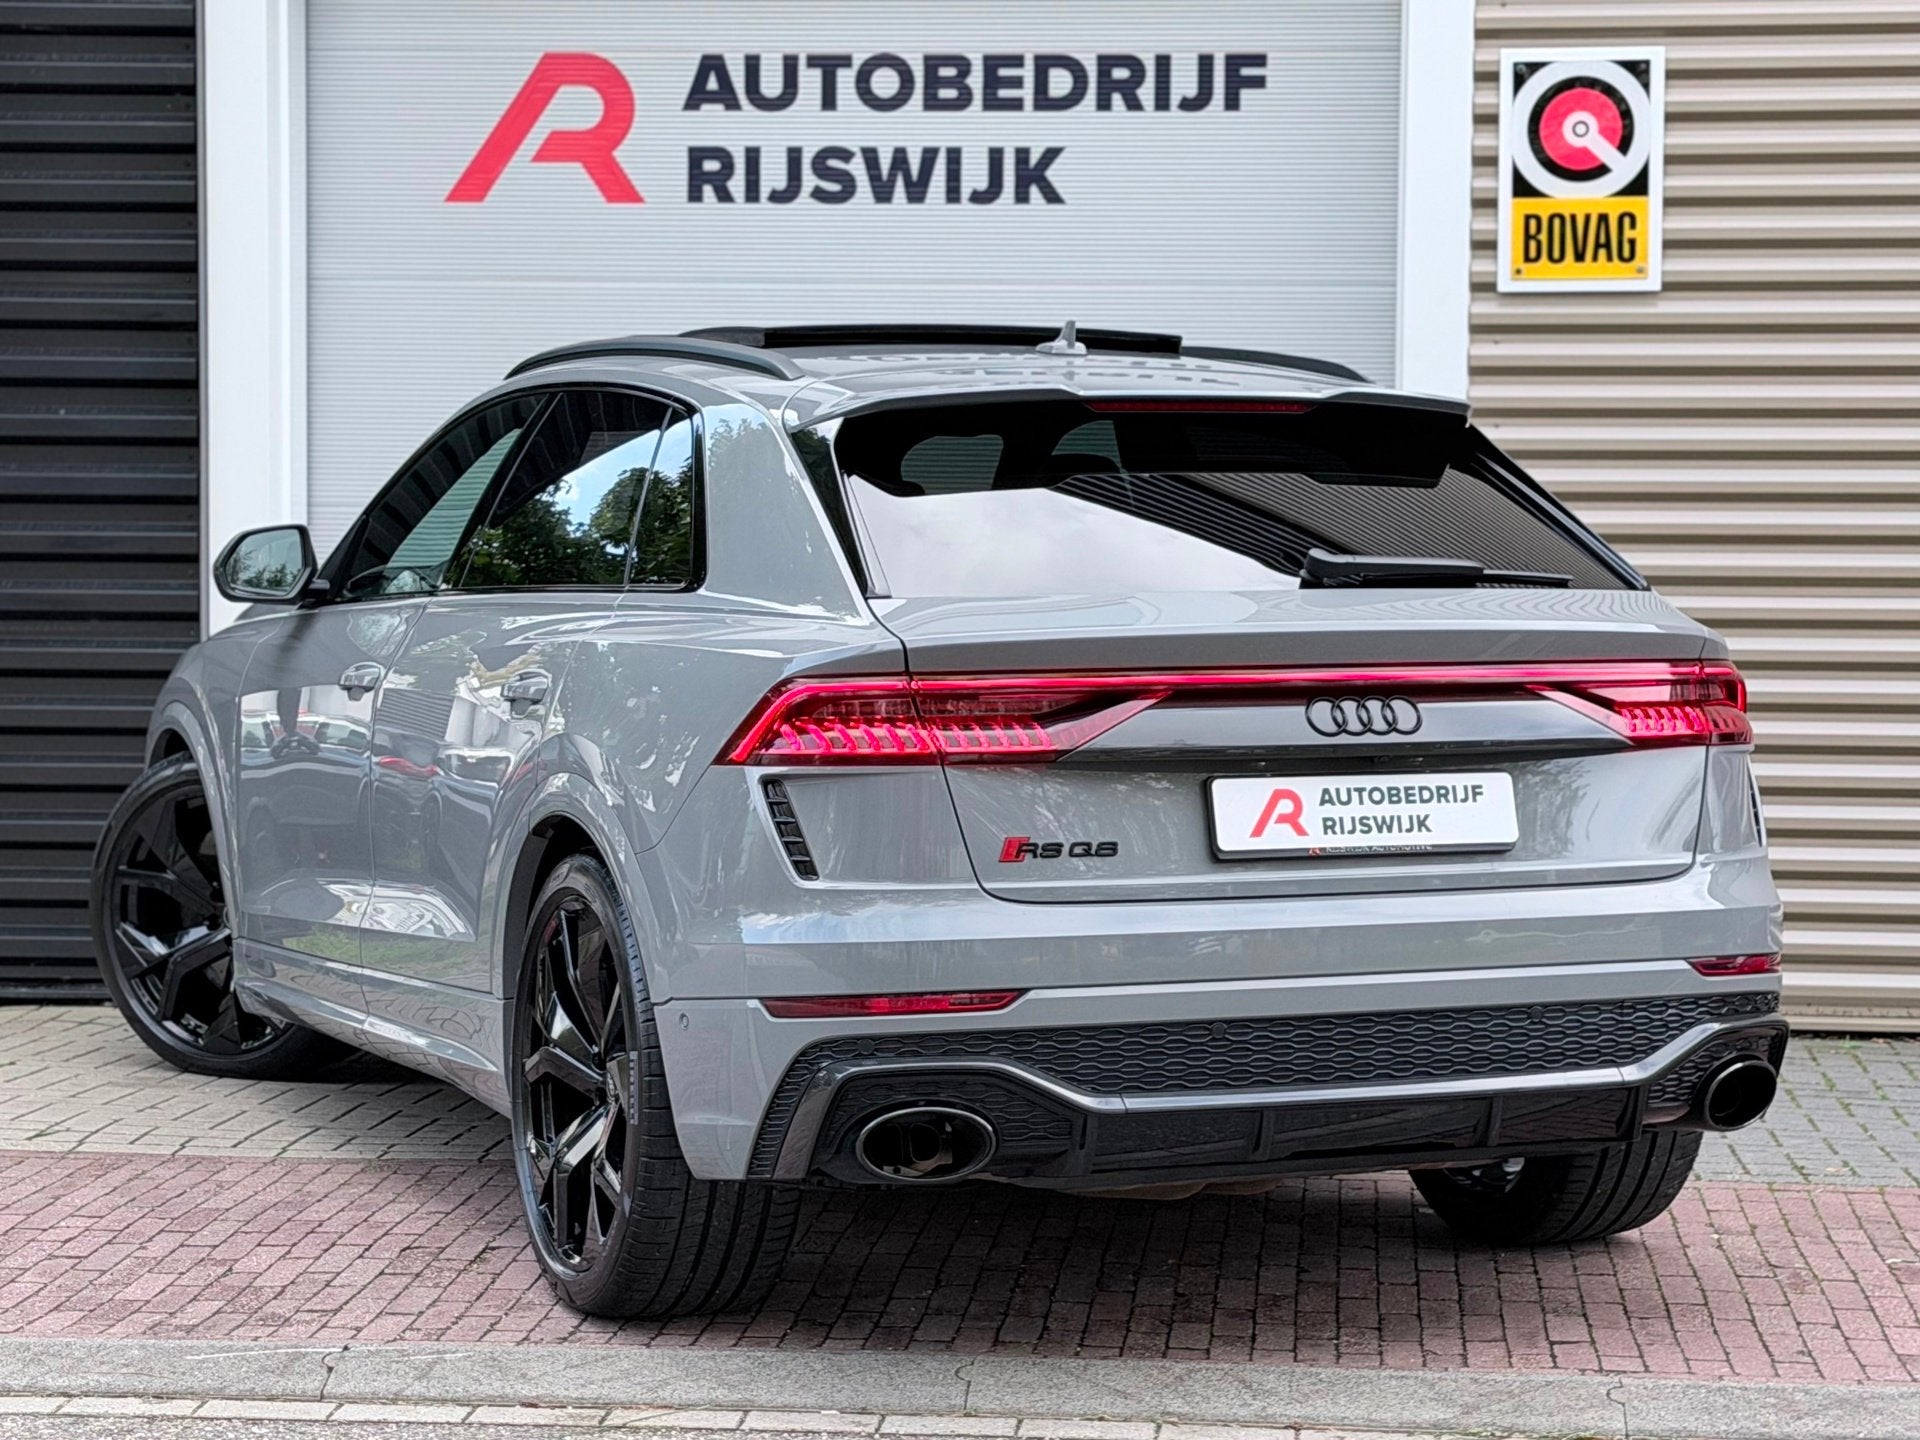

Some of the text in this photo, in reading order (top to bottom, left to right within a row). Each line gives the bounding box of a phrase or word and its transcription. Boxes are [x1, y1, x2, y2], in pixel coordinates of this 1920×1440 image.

[683, 53, 1267, 112] AUTOBEDRIJF
[687, 147, 1065, 205] RIJSWIJK
[1523, 212, 1637, 264] BOVAG
[1319, 785, 1484, 807] AUTOBEDRIJF
[1322, 814, 1432, 836] RIJSWIJK
[1013, 841, 1119, 859] RS Q8
